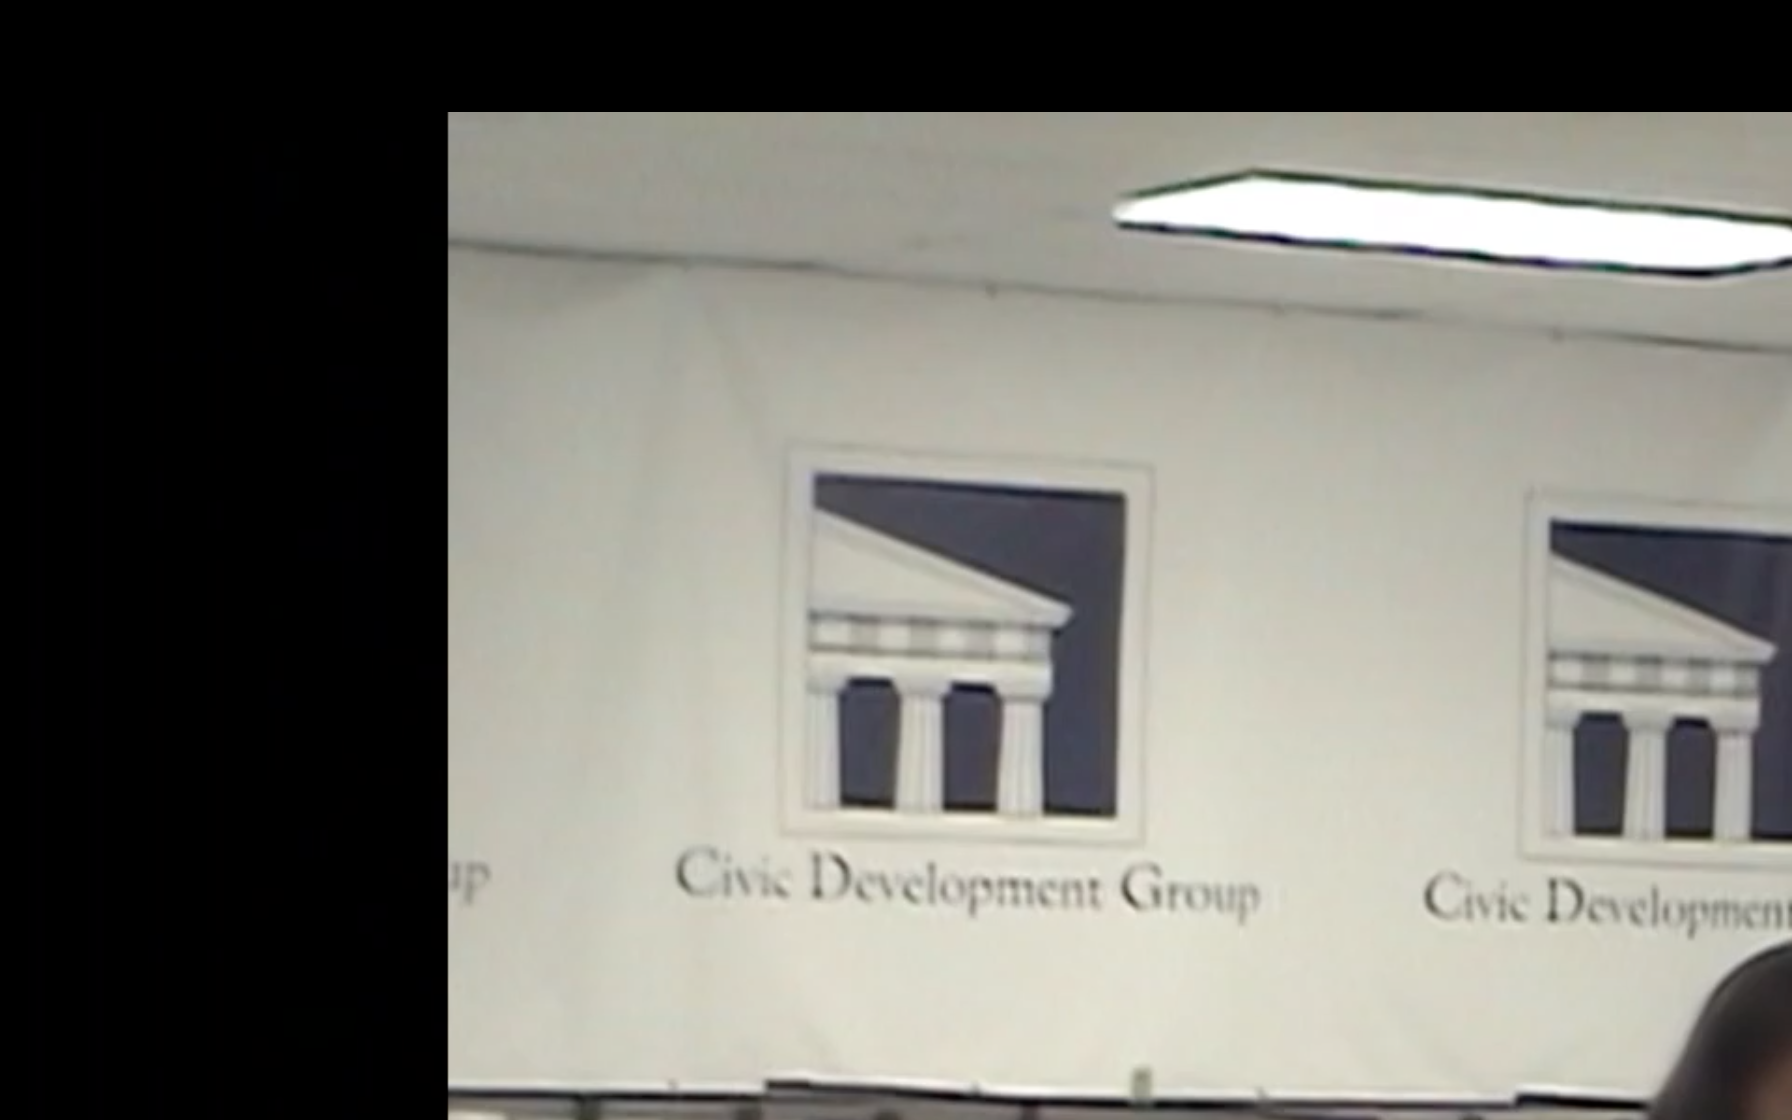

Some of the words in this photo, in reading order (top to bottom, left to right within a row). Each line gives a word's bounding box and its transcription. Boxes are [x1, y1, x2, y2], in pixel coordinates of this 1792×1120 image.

[674, 846, 792, 898] Civic
[810, 852, 1104, 917] Development
[1121, 862, 1263, 924] Group
[1423, 870, 1529, 924] Civic
